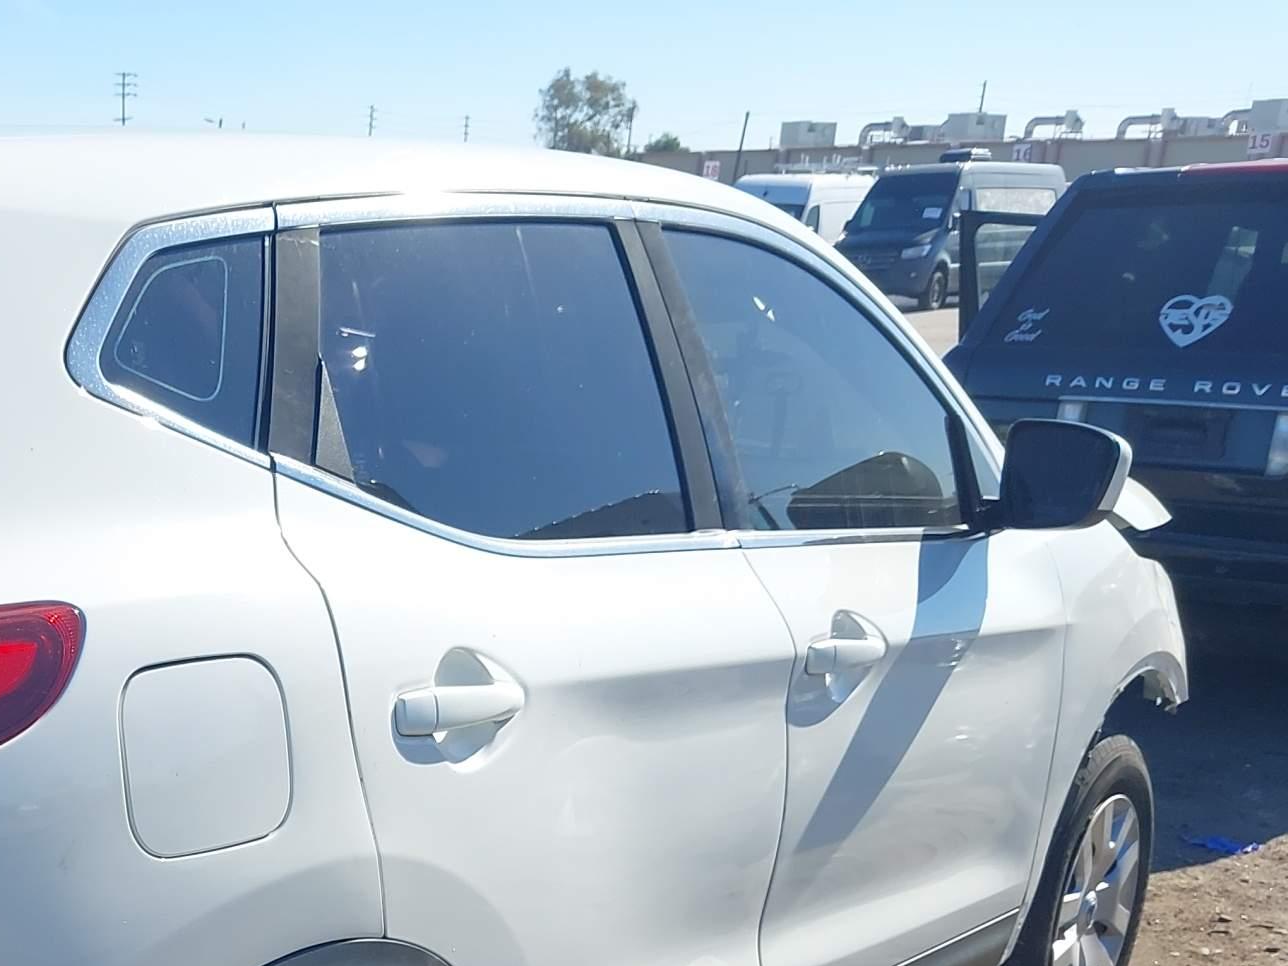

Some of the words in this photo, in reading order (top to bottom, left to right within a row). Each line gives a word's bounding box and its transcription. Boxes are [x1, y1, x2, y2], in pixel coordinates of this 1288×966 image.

[1249, 133, 1270, 149] 15
[1003, 329, 1042, 342] Good
[1044, 374, 1167, 391] RANGE
